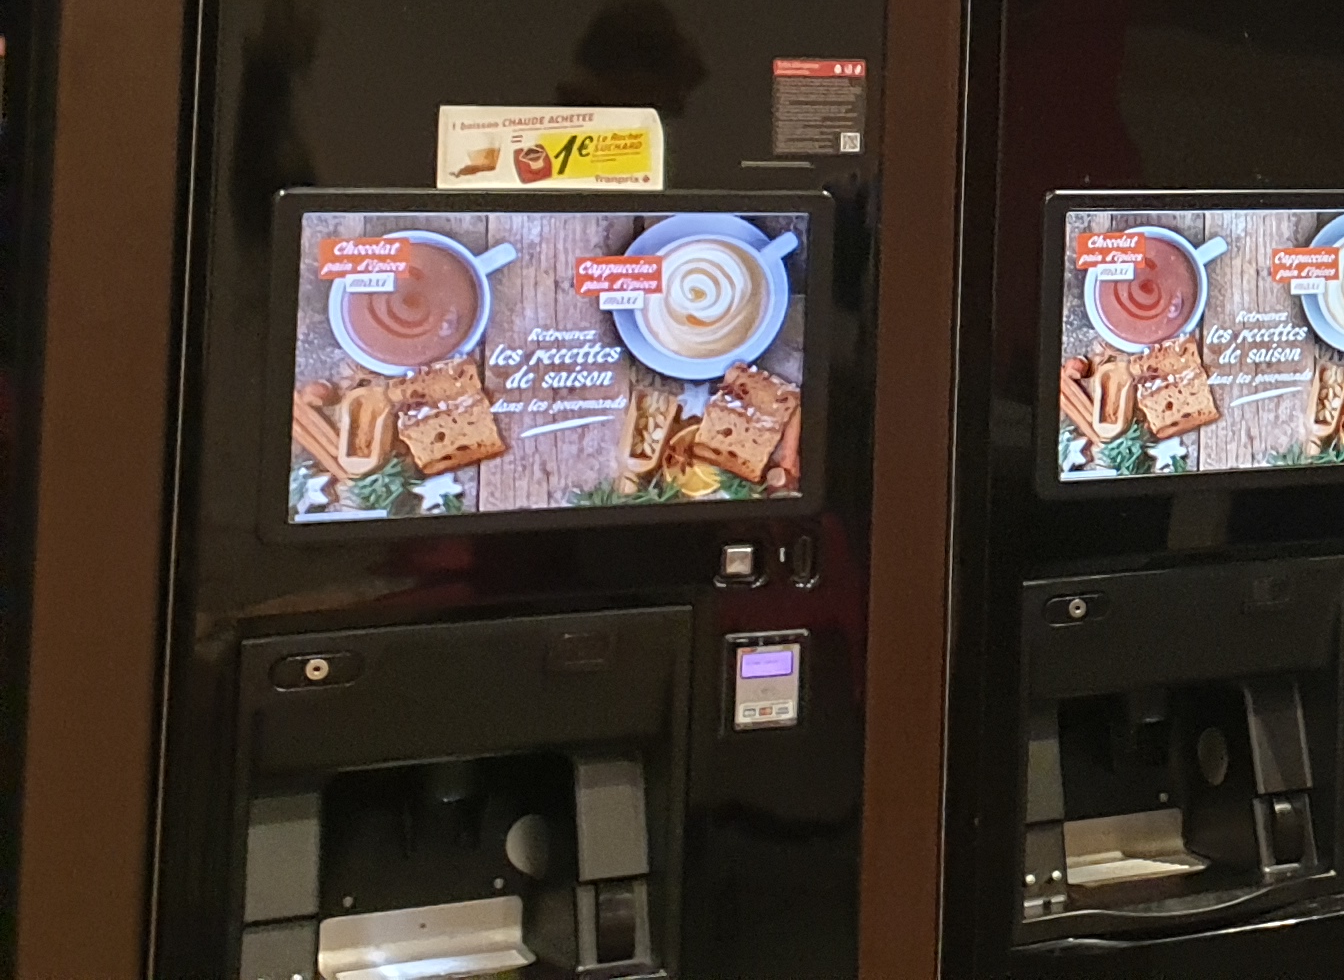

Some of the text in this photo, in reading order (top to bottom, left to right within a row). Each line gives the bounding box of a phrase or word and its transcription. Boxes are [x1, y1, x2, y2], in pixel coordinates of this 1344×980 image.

[502, 116, 545, 128] CHAUDE
[334, 240, 400, 255] Chocolat
[1087, 234, 1138, 248] Chocolat
[321, 259, 352, 275] pain
[1274, 250, 1336, 269] Cappuccino
[578, 260, 658, 281] Cappuccino
[349, 276, 389, 288] maxi
[580, 281, 609, 293] pain
[603, 294, 640, 304] maxi
[1235, 311, 1288, 323] Retrouvez
[528, 328, 598, 341] Retrouvez
[1206, 322, 1308, 344] les recettes
[489, 342, 622, 365] les recettes
[1218, 342, 1301, 365] de saison
[505, 365, 613, 389] de saison
[1207, 368, 1313, 386] dans les gourmands
[490, 394, 627, 414] dans les gourmands
